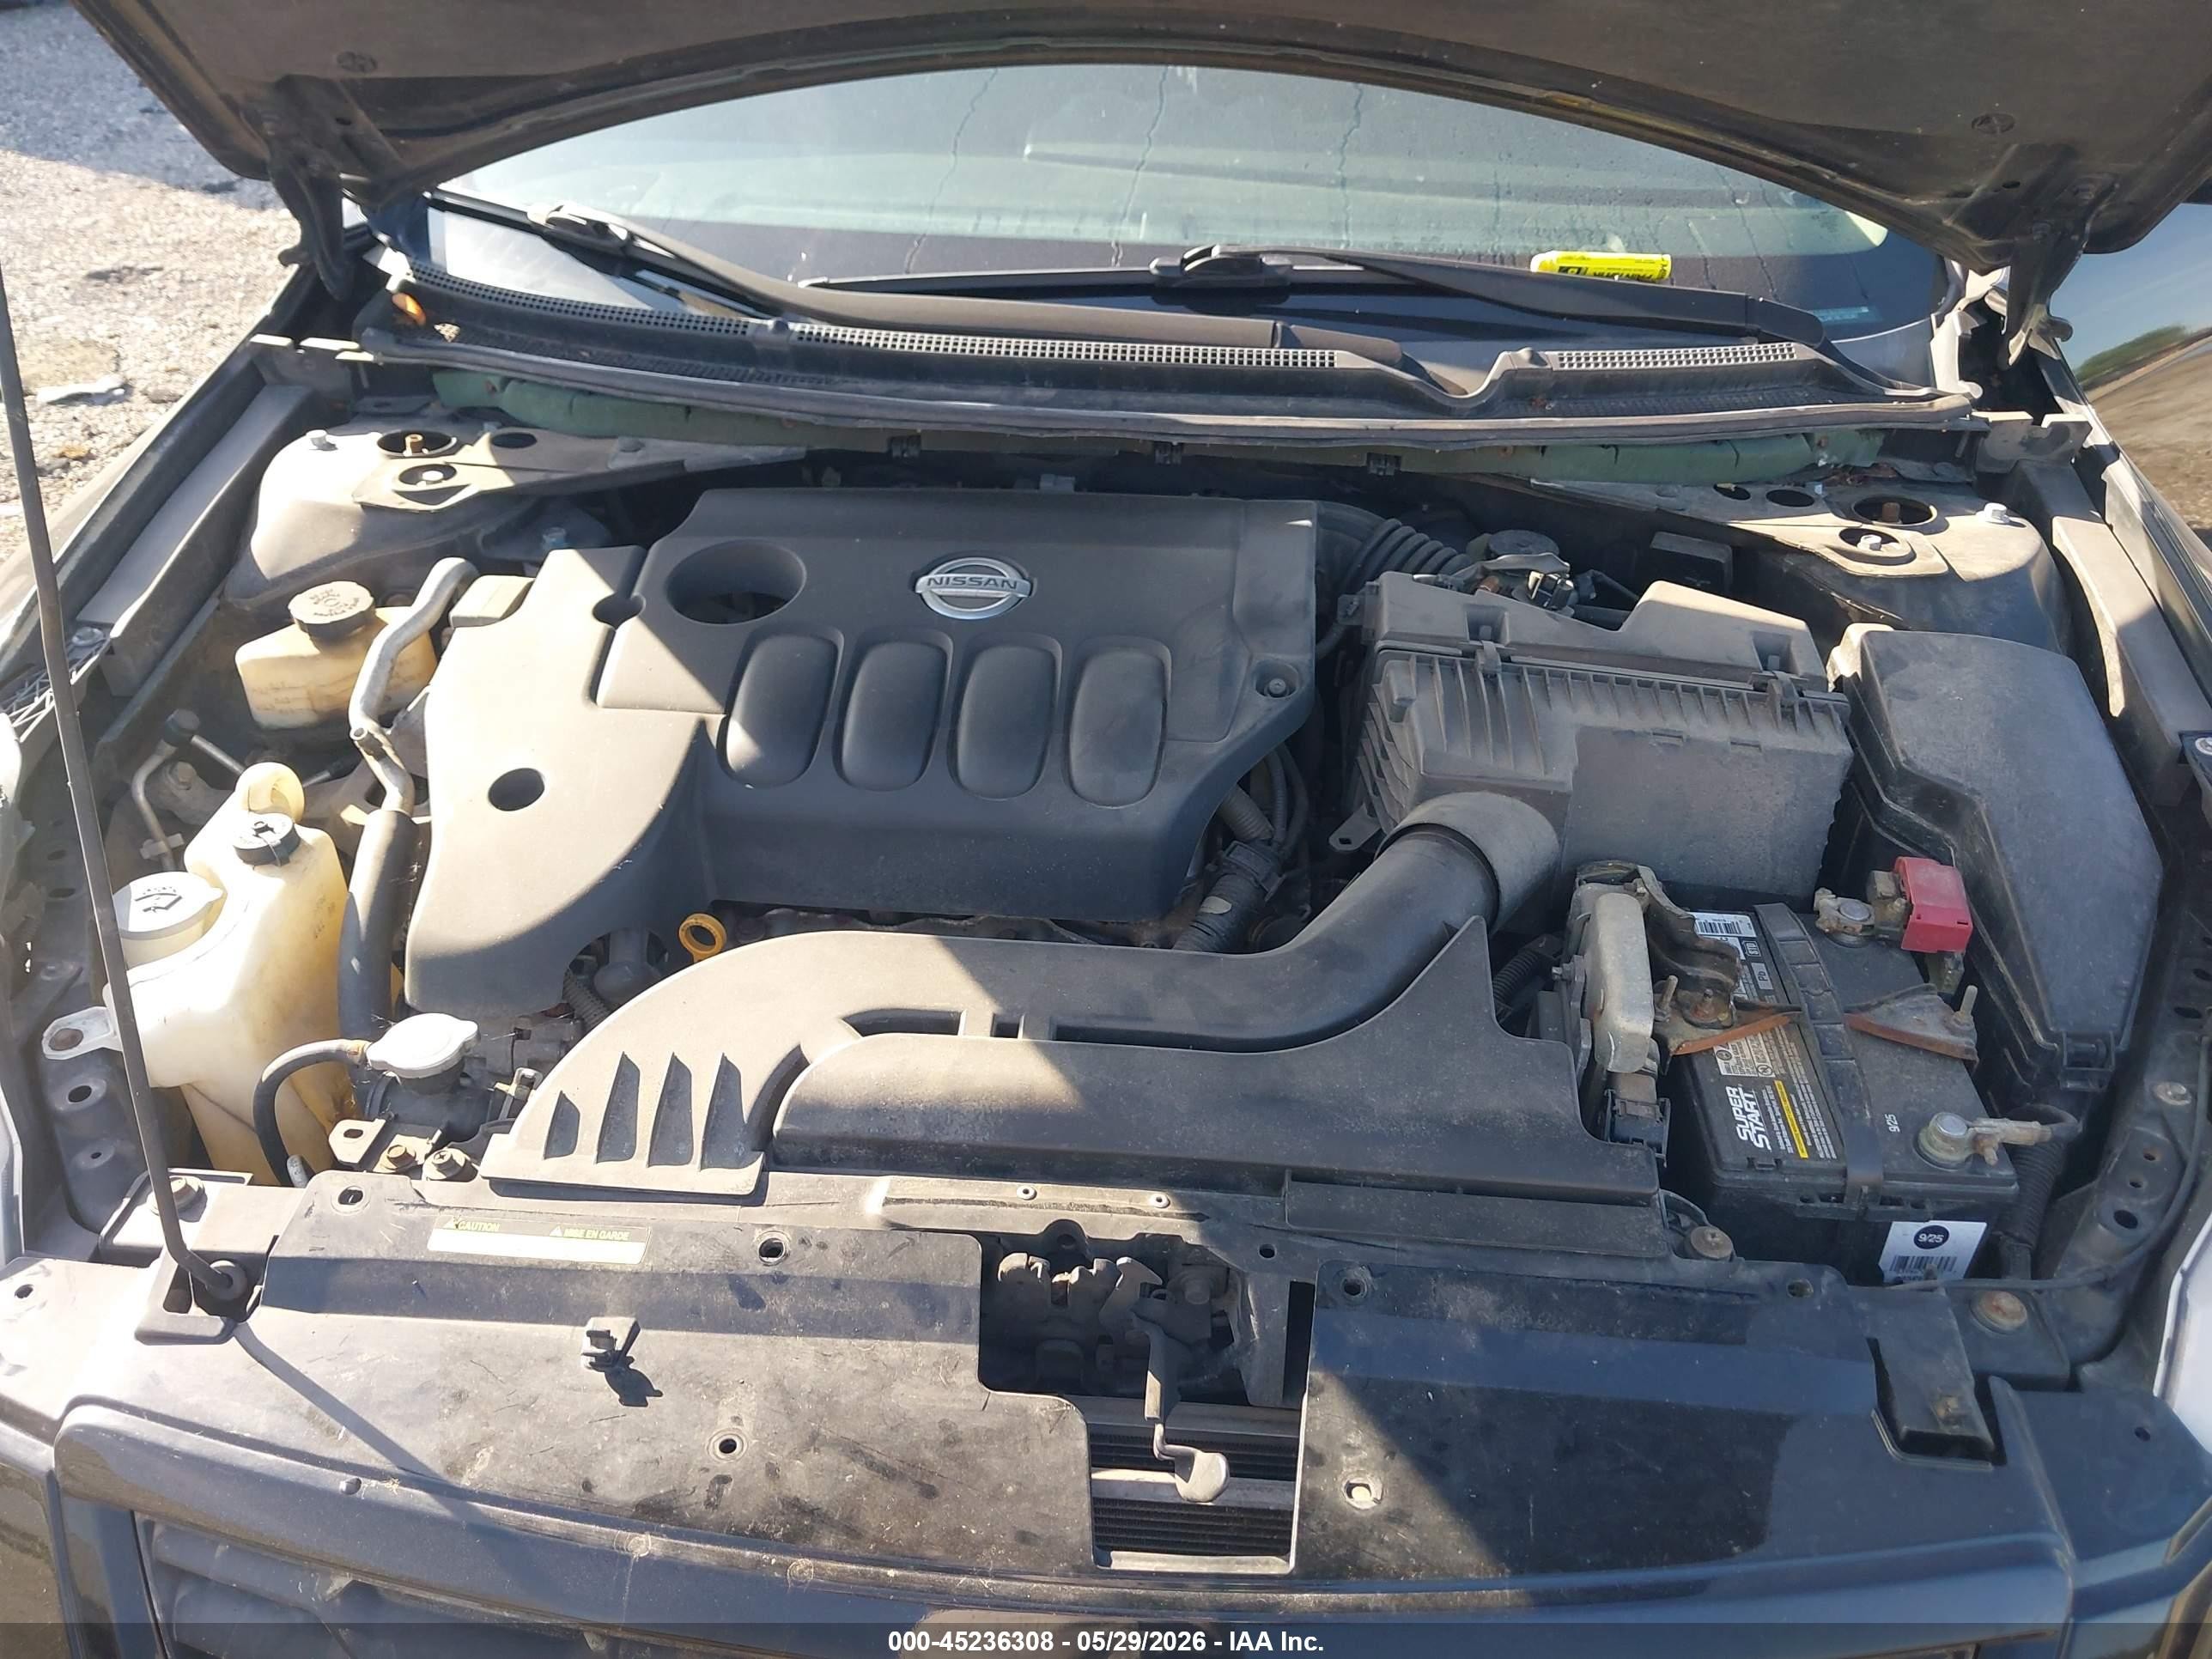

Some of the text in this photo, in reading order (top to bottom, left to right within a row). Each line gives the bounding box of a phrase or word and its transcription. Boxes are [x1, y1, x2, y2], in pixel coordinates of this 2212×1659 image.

[927, 576, 1018, 590] NISSAN
[1758, 970, 1769, 982] Pb
[1725, 1085, 1750, 1141] SUPER
[1739, 1086, 1772, 1152] START
[1884, 1113, 1900, 1133] 9/25
[458, 1220, 501, 1232] CAUTION
[562, 1228, 630, 1241] MISE EN GARDE
[1917, 1232, 1945, 1244] 9/25
